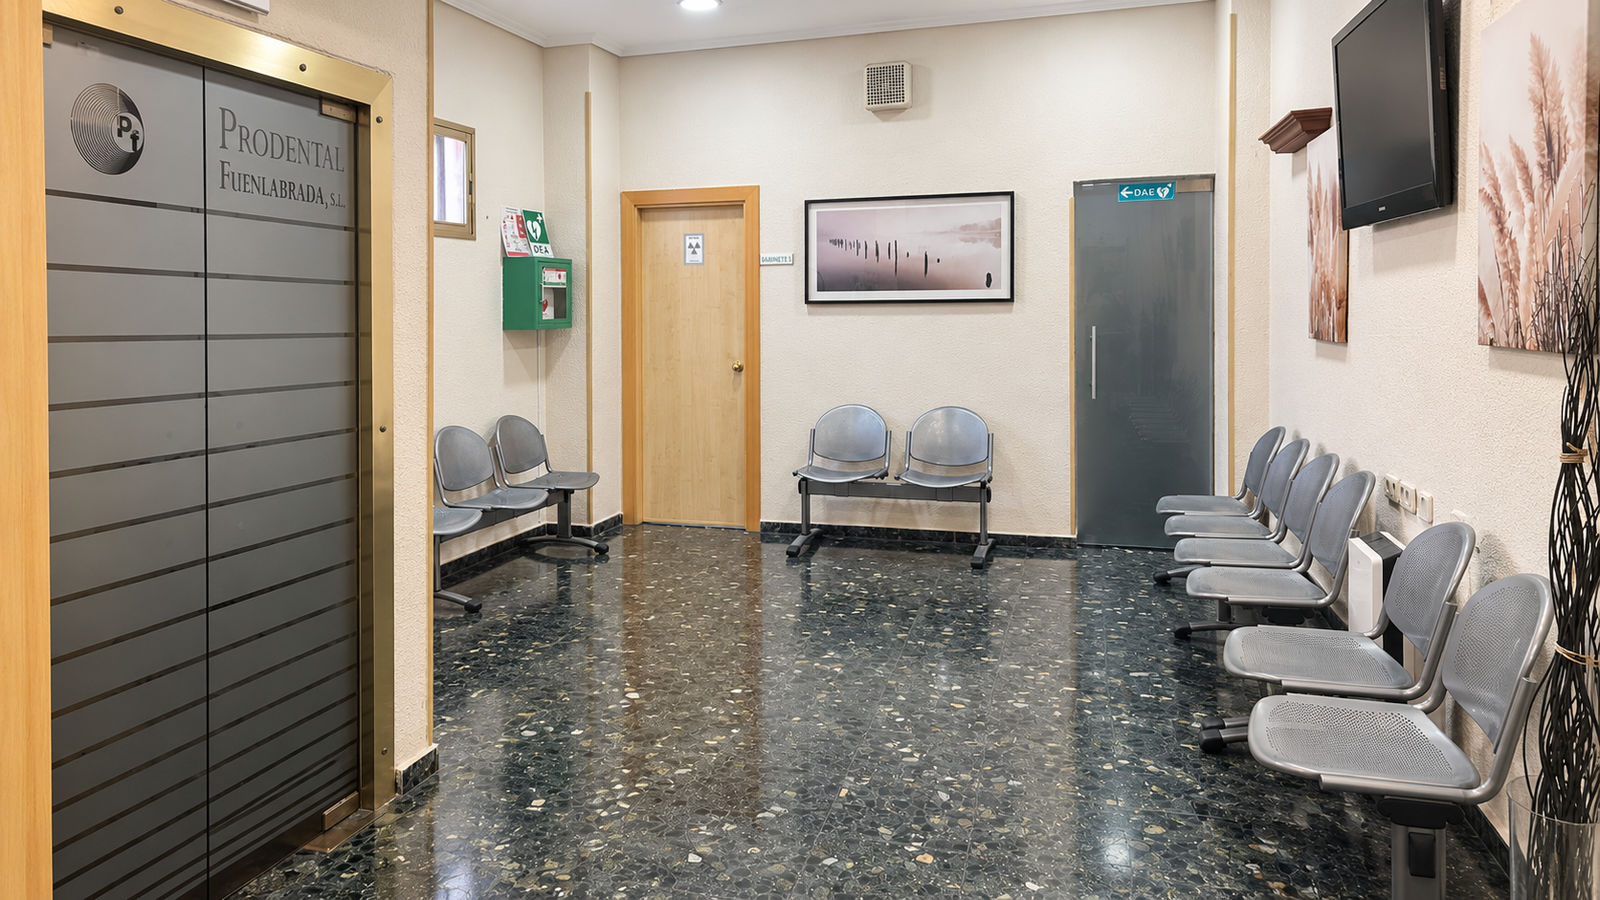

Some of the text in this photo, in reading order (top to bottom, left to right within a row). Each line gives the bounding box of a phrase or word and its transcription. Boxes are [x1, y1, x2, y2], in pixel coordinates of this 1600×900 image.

[218, 106, 345, 172] PRODENTAL
[1134, 188, 1155, 197] DAE
[533, 244, 550, 254] DEA
